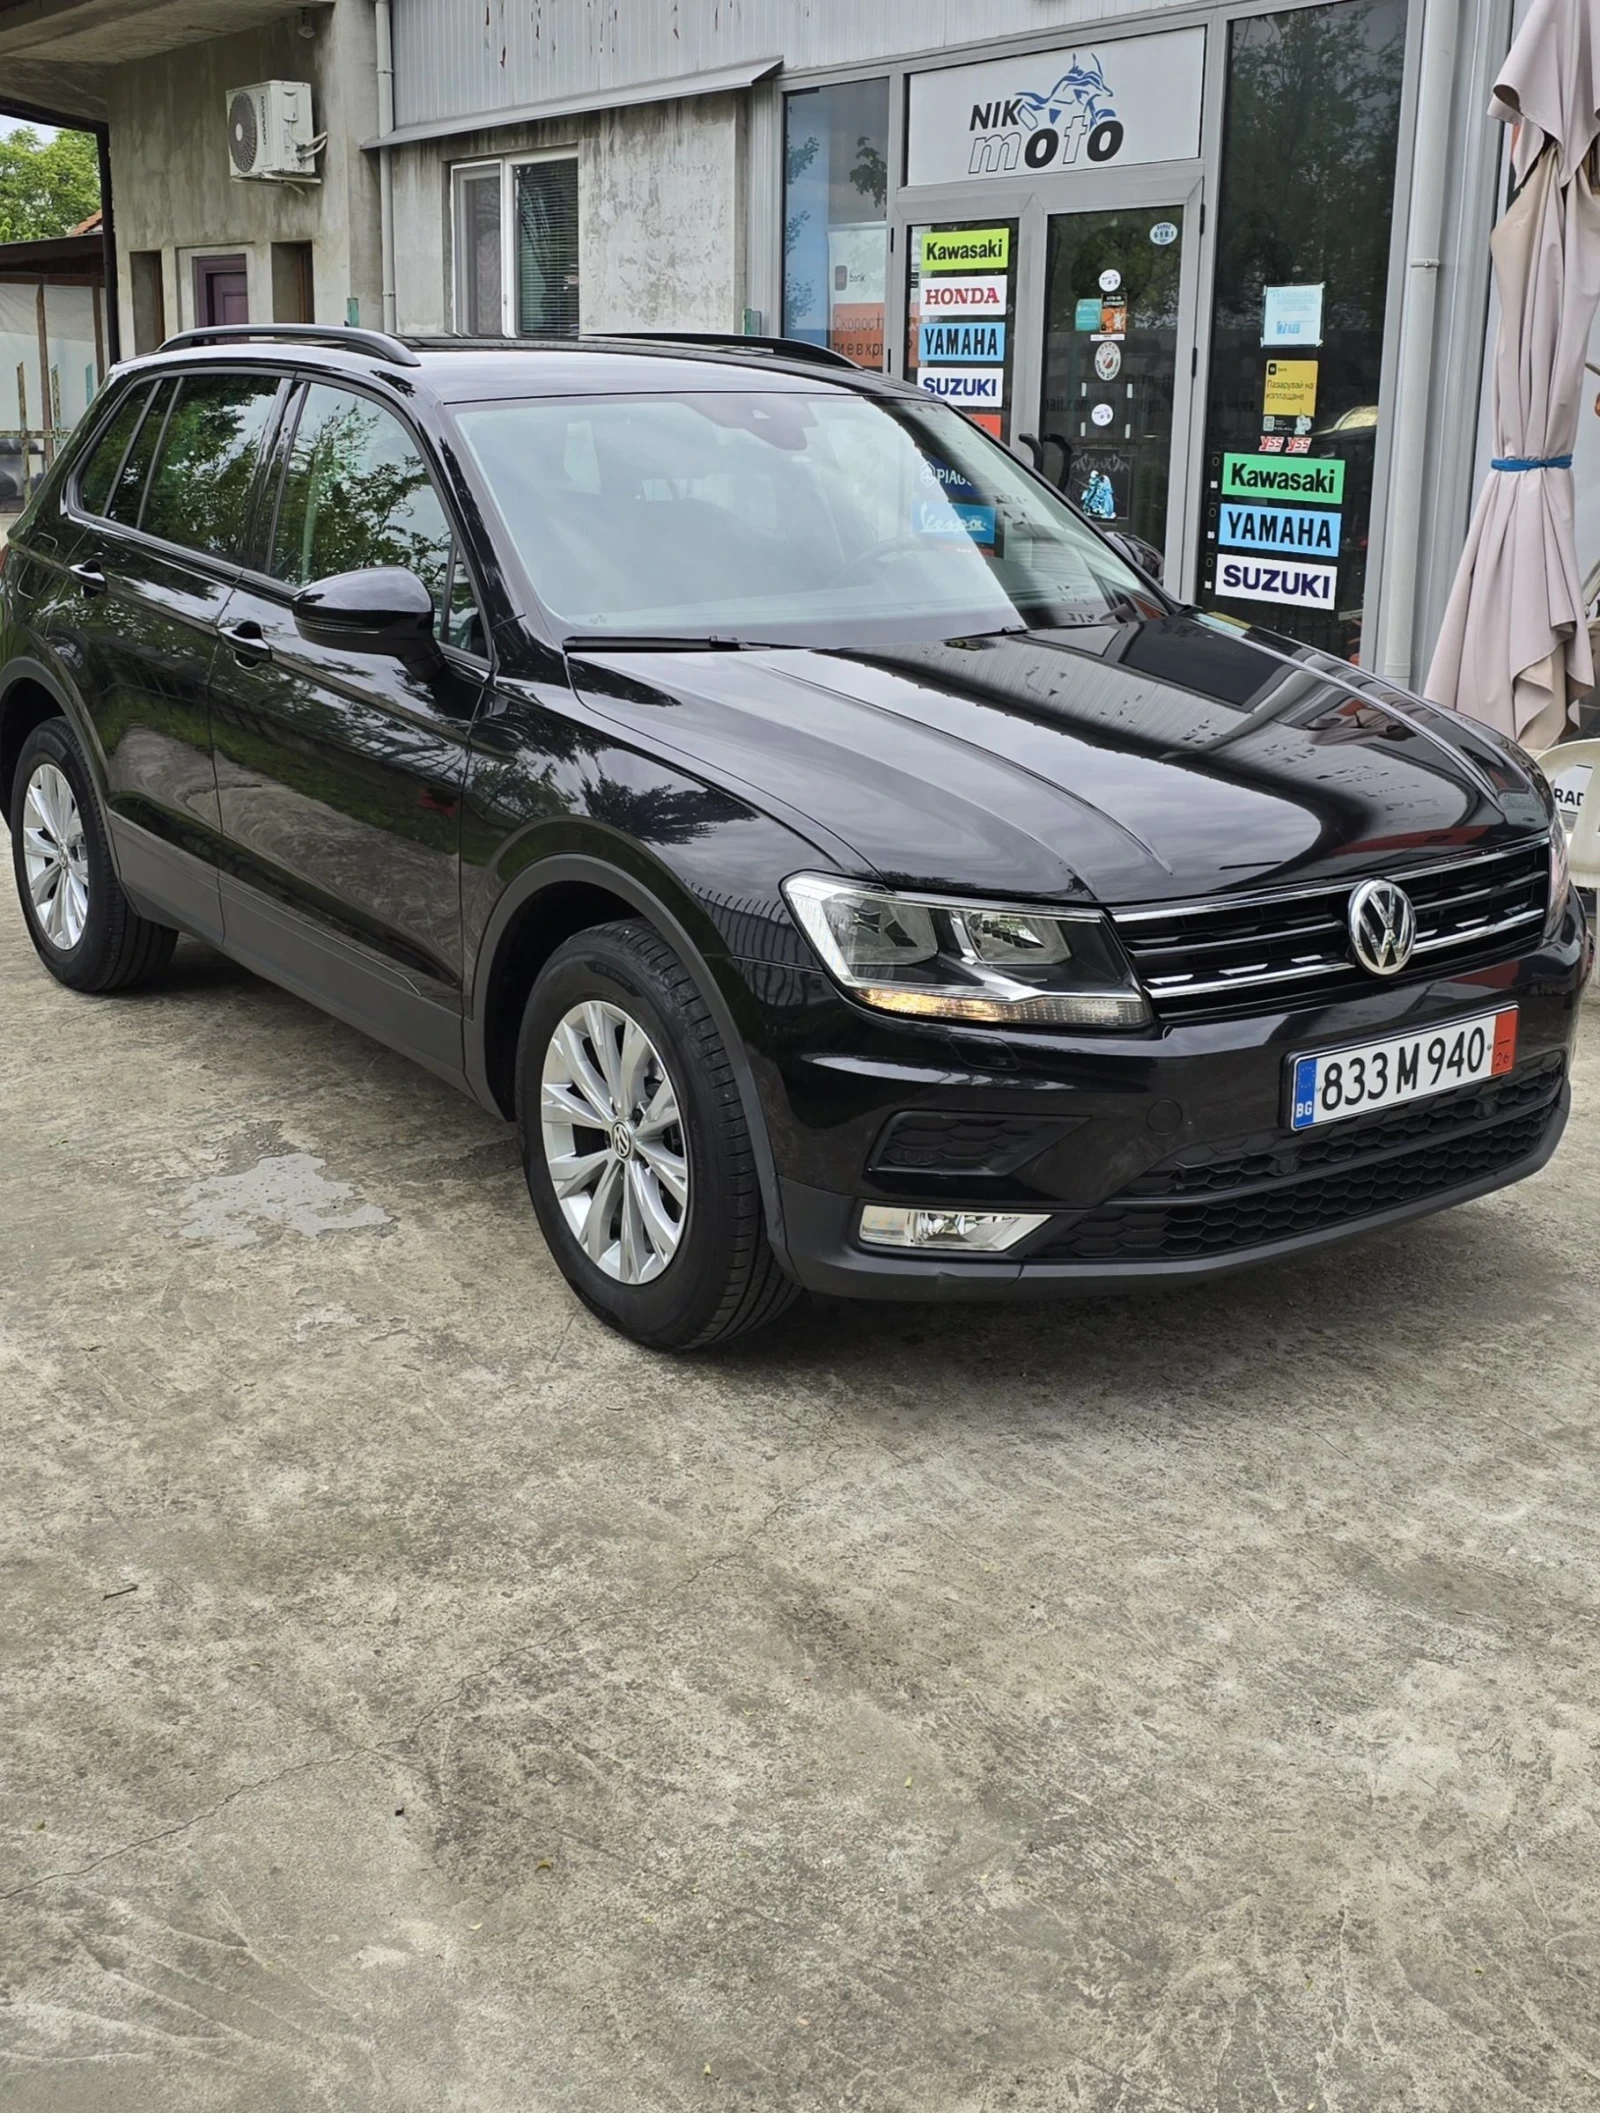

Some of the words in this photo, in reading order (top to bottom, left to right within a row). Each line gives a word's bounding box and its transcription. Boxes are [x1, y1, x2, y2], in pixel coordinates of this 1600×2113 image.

[969, 98, 1023, 131] NIK
[968, 115, 1124, 174] moto
[926, 239, 1003, 261] Kawasaki
[925, 287, 1000, 305] HONDA
[924, 328, 998, 356] YAMAHA
[923, 377, 997, 397] SUZUKI
[1266, 379, 1304, 391] Пазарувай
[1305, 382, 1315, 390] на
[1266, 392, 1305, 402] изплащане
[1231, 463, 1335, 494] Kawasaki
[1228, 511, 1331, 548] YAMAHA
[1223, 564, 1330, 599] SUZUKI
[1321, 1051, 1388, 1111] 833
[1396, 1042, 1420, 1095] M
[1427, 1026, 1485, 1086] 940
[1495, 1051, 1509, 1067] 26
[1295, 1100, 1313, 1118] BG
